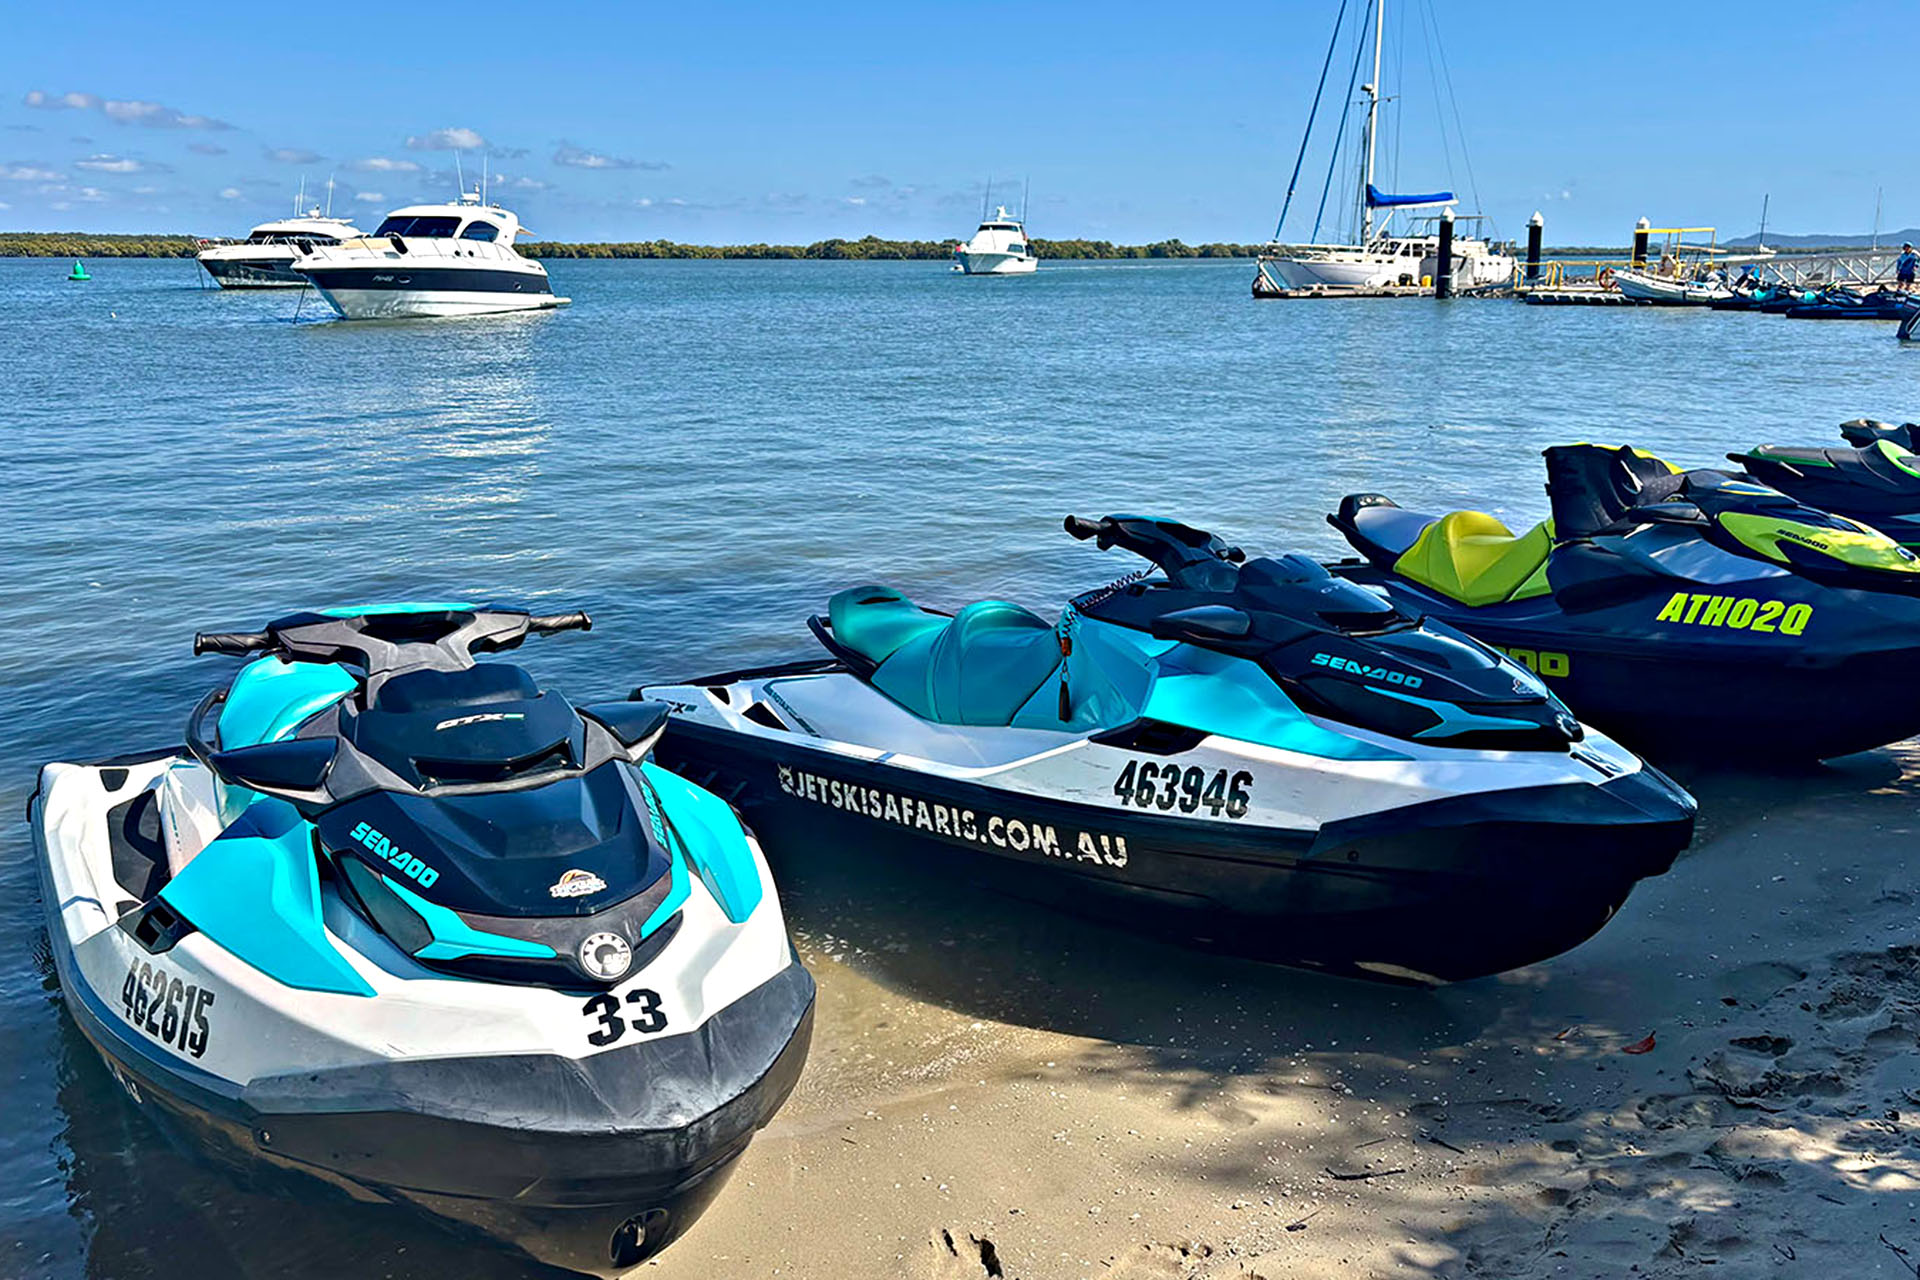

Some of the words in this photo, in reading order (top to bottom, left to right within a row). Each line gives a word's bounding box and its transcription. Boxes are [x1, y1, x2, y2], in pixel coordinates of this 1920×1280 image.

[1114, 760, 1254, 819] 463946
[122, 956, 215, 1059] 462615
[582, 988, 669, 1047] 33
